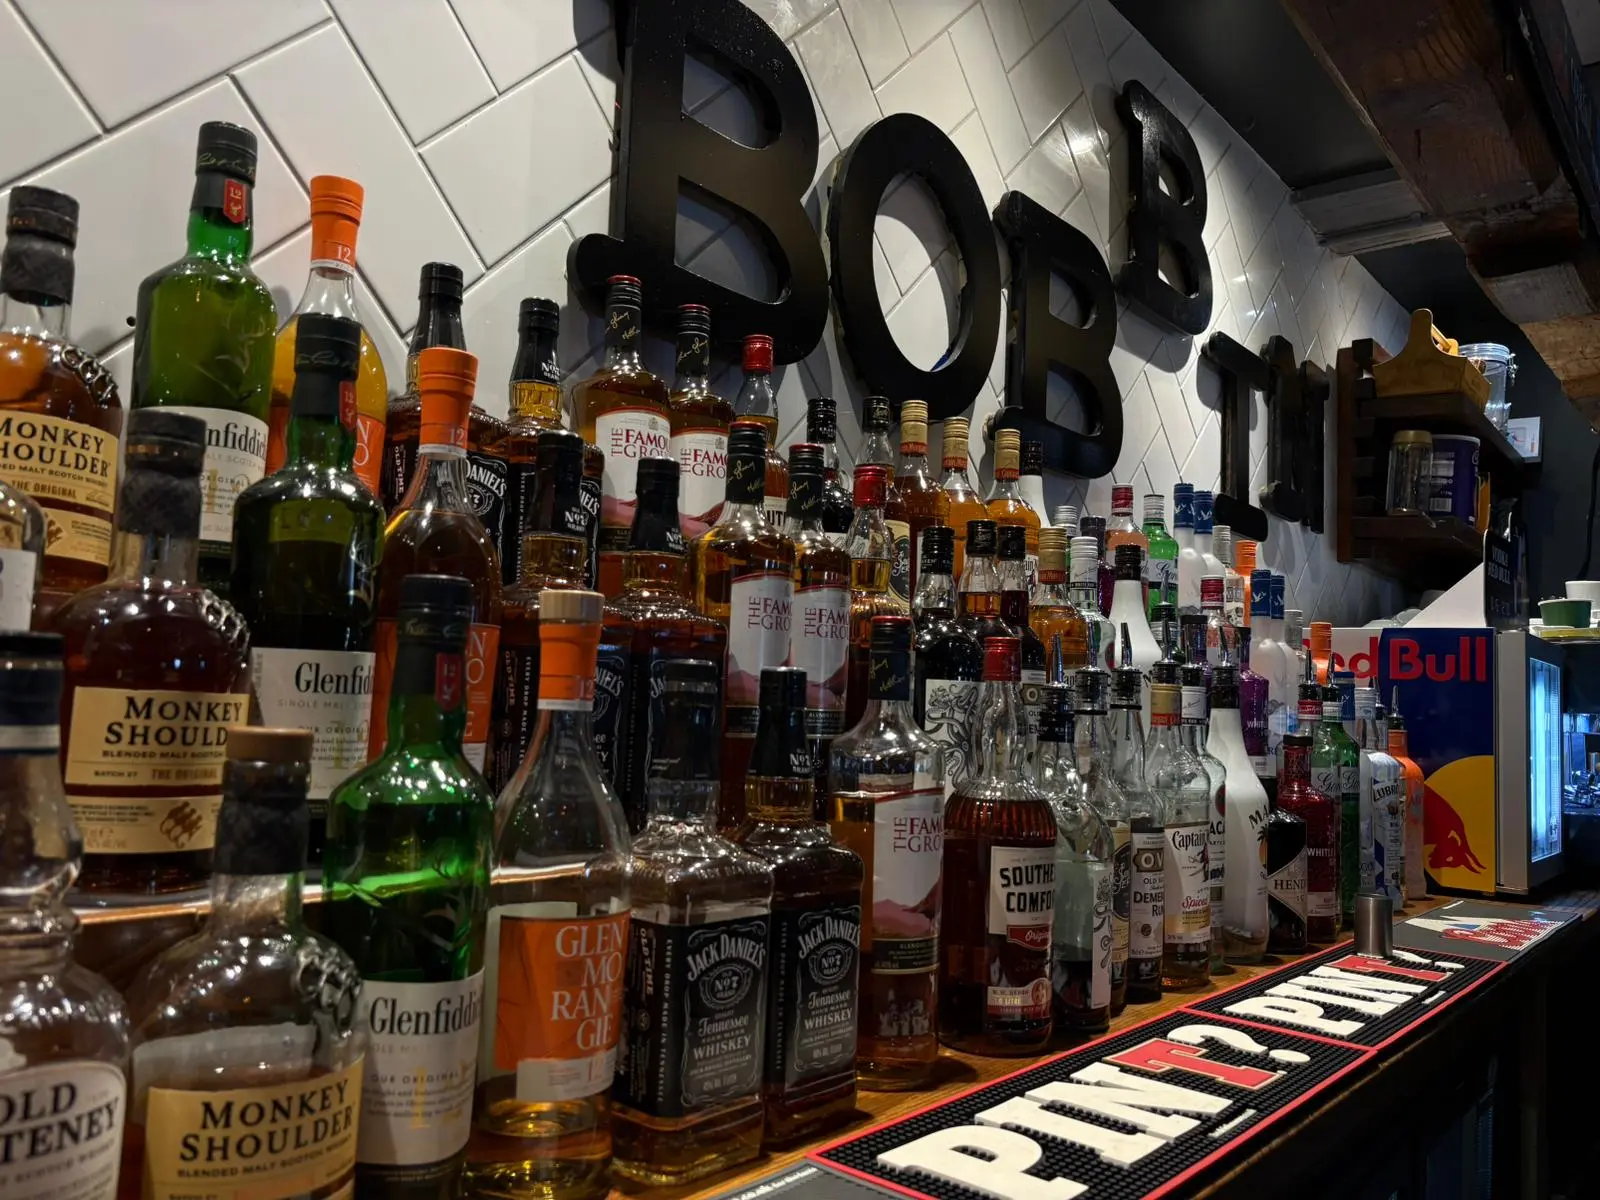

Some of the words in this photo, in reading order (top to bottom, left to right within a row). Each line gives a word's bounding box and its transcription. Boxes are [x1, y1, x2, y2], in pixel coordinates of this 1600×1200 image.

[336, 245, 351, 262] 12
[0, 417, 104, 453] MONKEY
[450, 428, 467, 447] 12
[0, 442, 109, 479] HOULDER
[692, 463, 727, 478] GRO
[748, 595, 761, 628] THE
[761, 614, 793, 632] GRO
[804, 607, 817, 637] THE
[1389, 636, 1487, 682] Bull
[124, 696, 242, 722] MONKEY
[105, 721, 229, 747] SHOULD
[102, 749, 157, 760] BLENDED
[158, 750, 188, 760] MALT
[94, 769, 125, 779] BATCH
[894, 816, 907, 853] THE
[907, 835, 942, 853] GRO
[1141, 852, 1165, 868] OV
[1000, 863, 1055, 888] SOUTHE
[1006, 890, 1055, 913] COMFO
[555, 921, 625, 958] GLEN
[798, 933, 824, 959] JACK
[582, 951, 623, 987] MO
[687, 941, 721, 982] JACK
[719, 933, 767, 969] DANIEL'S
[551, 983, 613, 1021] RAN
[808, 989, 851, 1010] Tennessee
[698, 1014, 749, 1037] Tennessee
[804, 1008, 853, 1030] WHISKEY
[576, 1014, 614, 1051] GIE
[693, 1034, 752, 1061] WHISKEY
[202, 1079, 348, 1130] MONKEY
[877, 1024, 1310, 1200] PINT?
[0, 1097, 120, 1164] TENEY
[179, 1105, 353, 1162] SHOULDER
[177, 1167, 238, 1179] BLENDED
[242, 1161, 276, 1176] MALT
